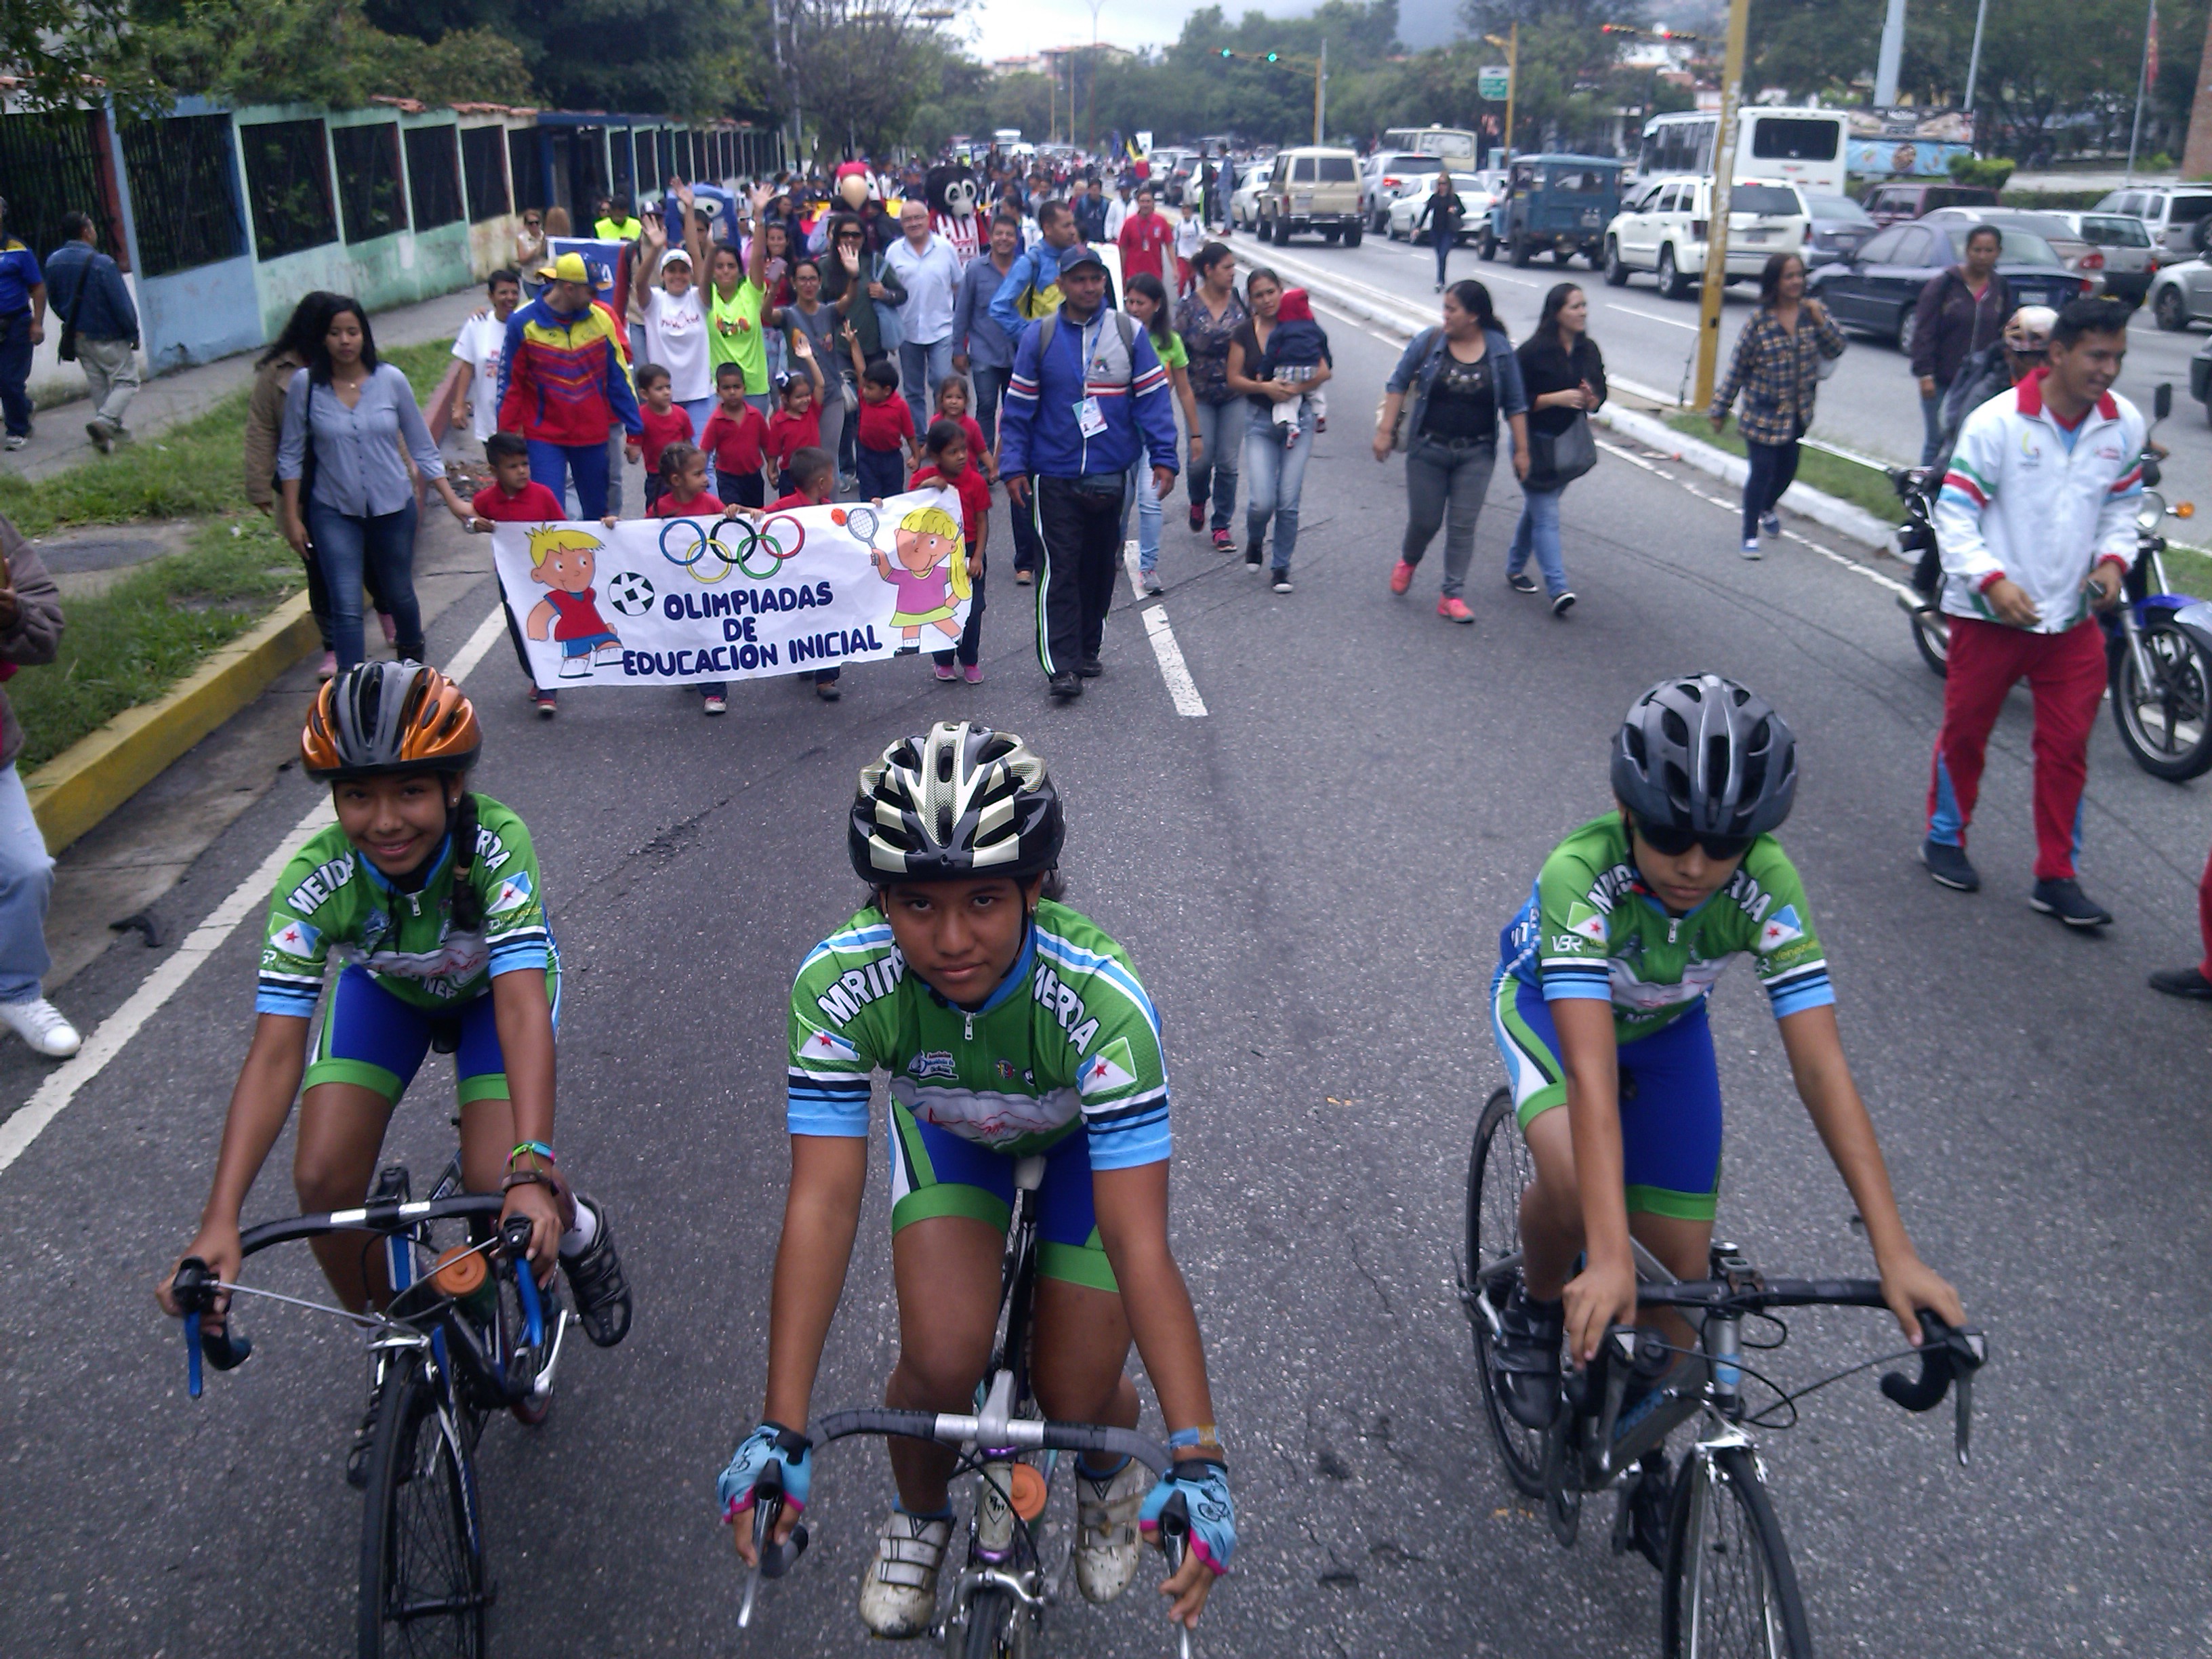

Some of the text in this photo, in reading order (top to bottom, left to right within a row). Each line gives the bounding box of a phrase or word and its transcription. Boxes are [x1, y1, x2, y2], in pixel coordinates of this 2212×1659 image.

[663, 581, 834, 620] OLIMPIADAS
[723, 617, 758, 642] DE
[788, 625, 883, 663] INICIAL
[1551, 934, 1583, 952] VBR
